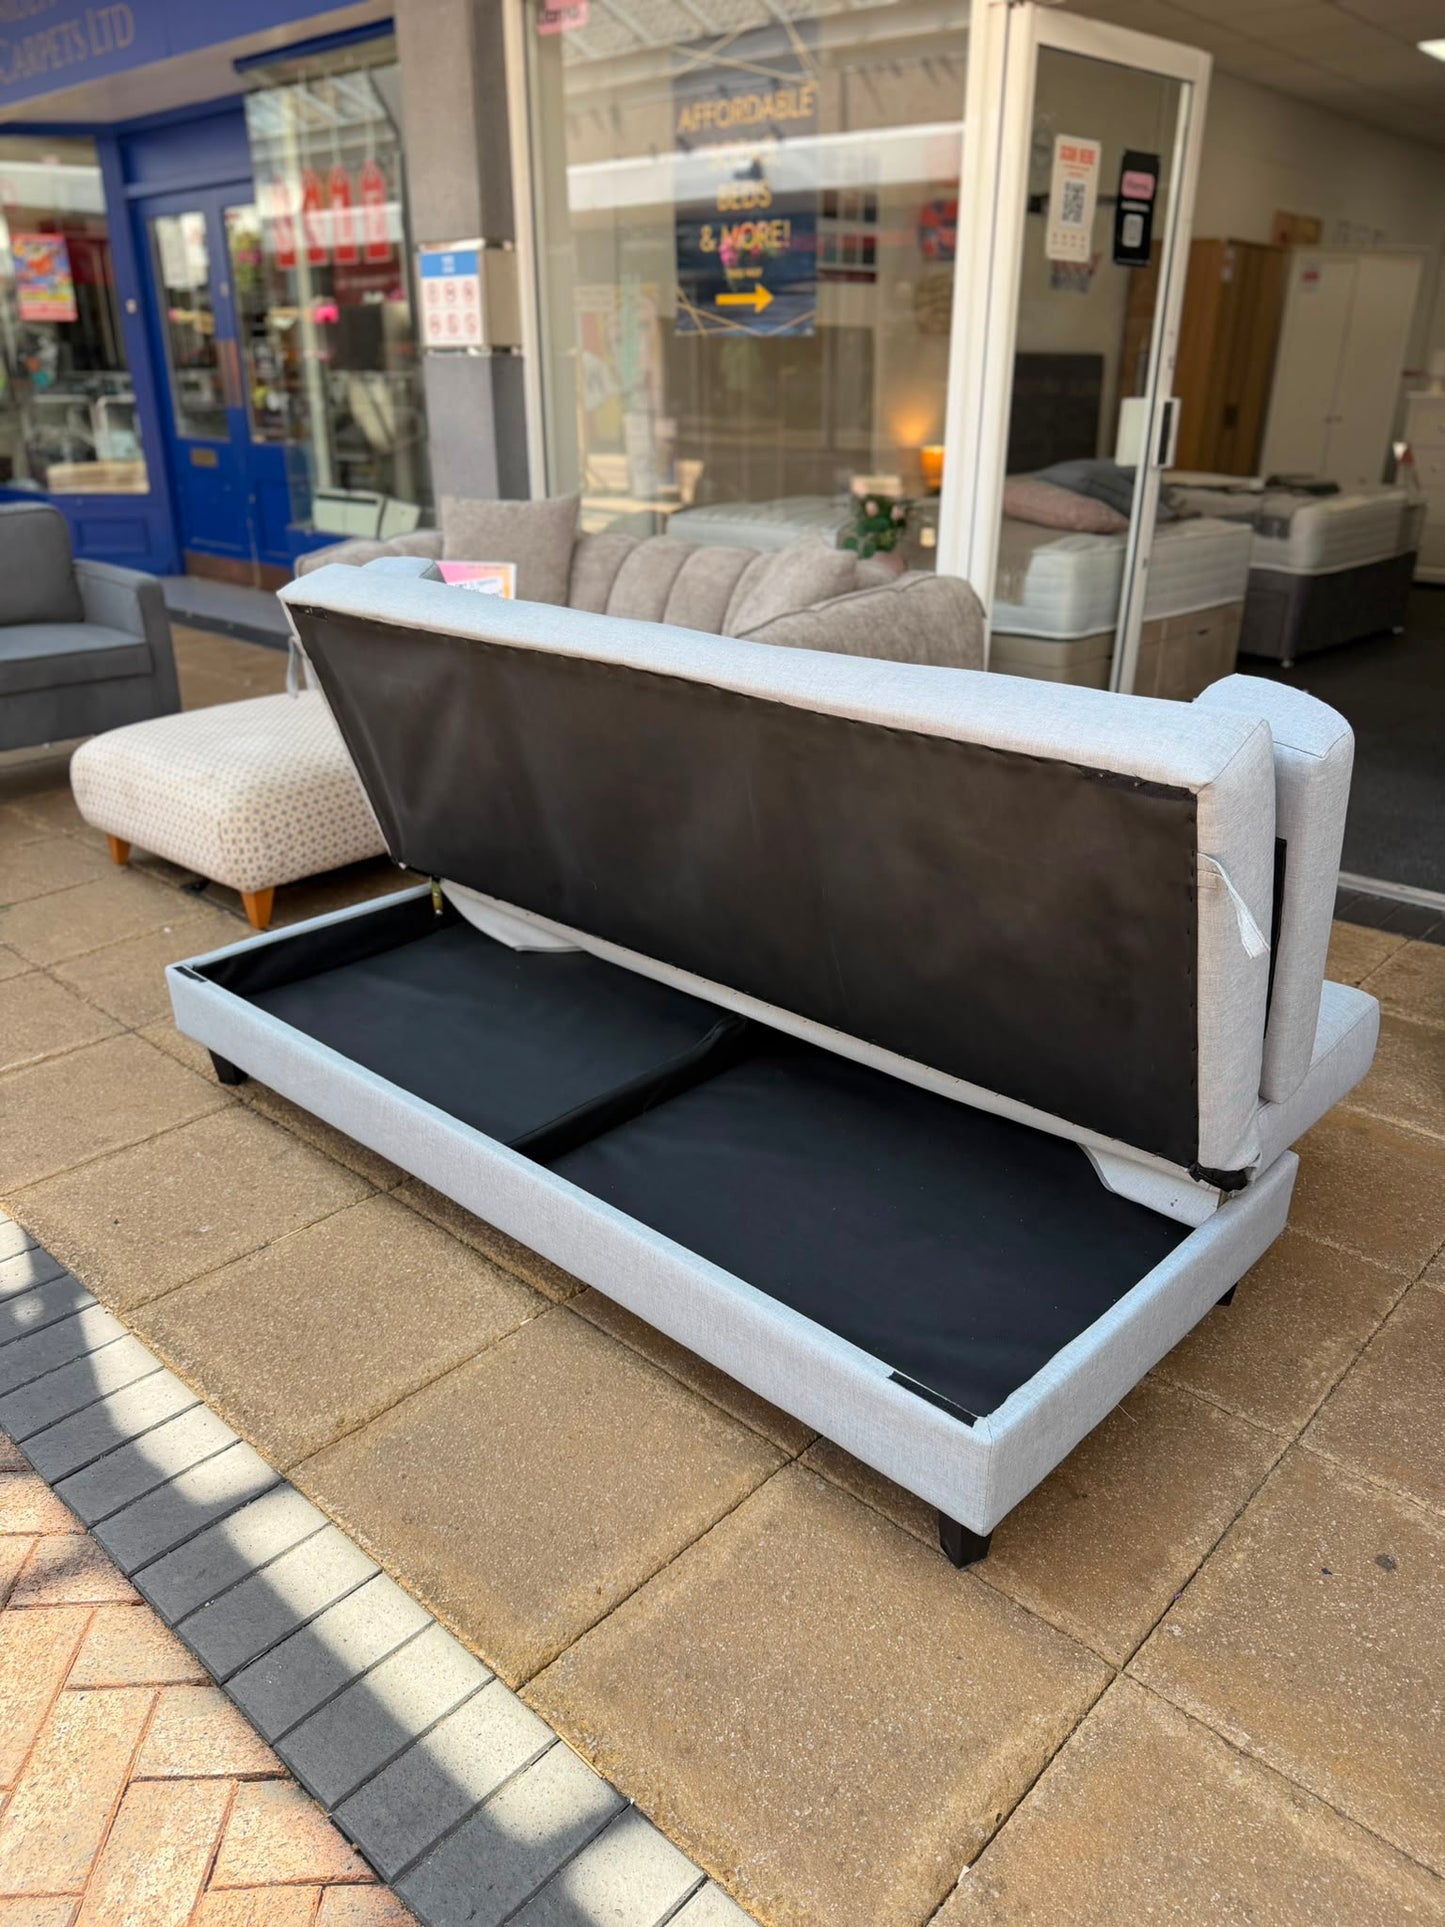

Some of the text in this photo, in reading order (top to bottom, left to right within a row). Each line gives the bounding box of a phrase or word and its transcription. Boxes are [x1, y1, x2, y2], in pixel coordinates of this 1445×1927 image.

[85, 2, 136, 56] LTD
[678, 86, 816, 132] AFFORDABLE
[716, 179, 772, 211] BEDS
[700, 219, 791, 252] & MORE!
